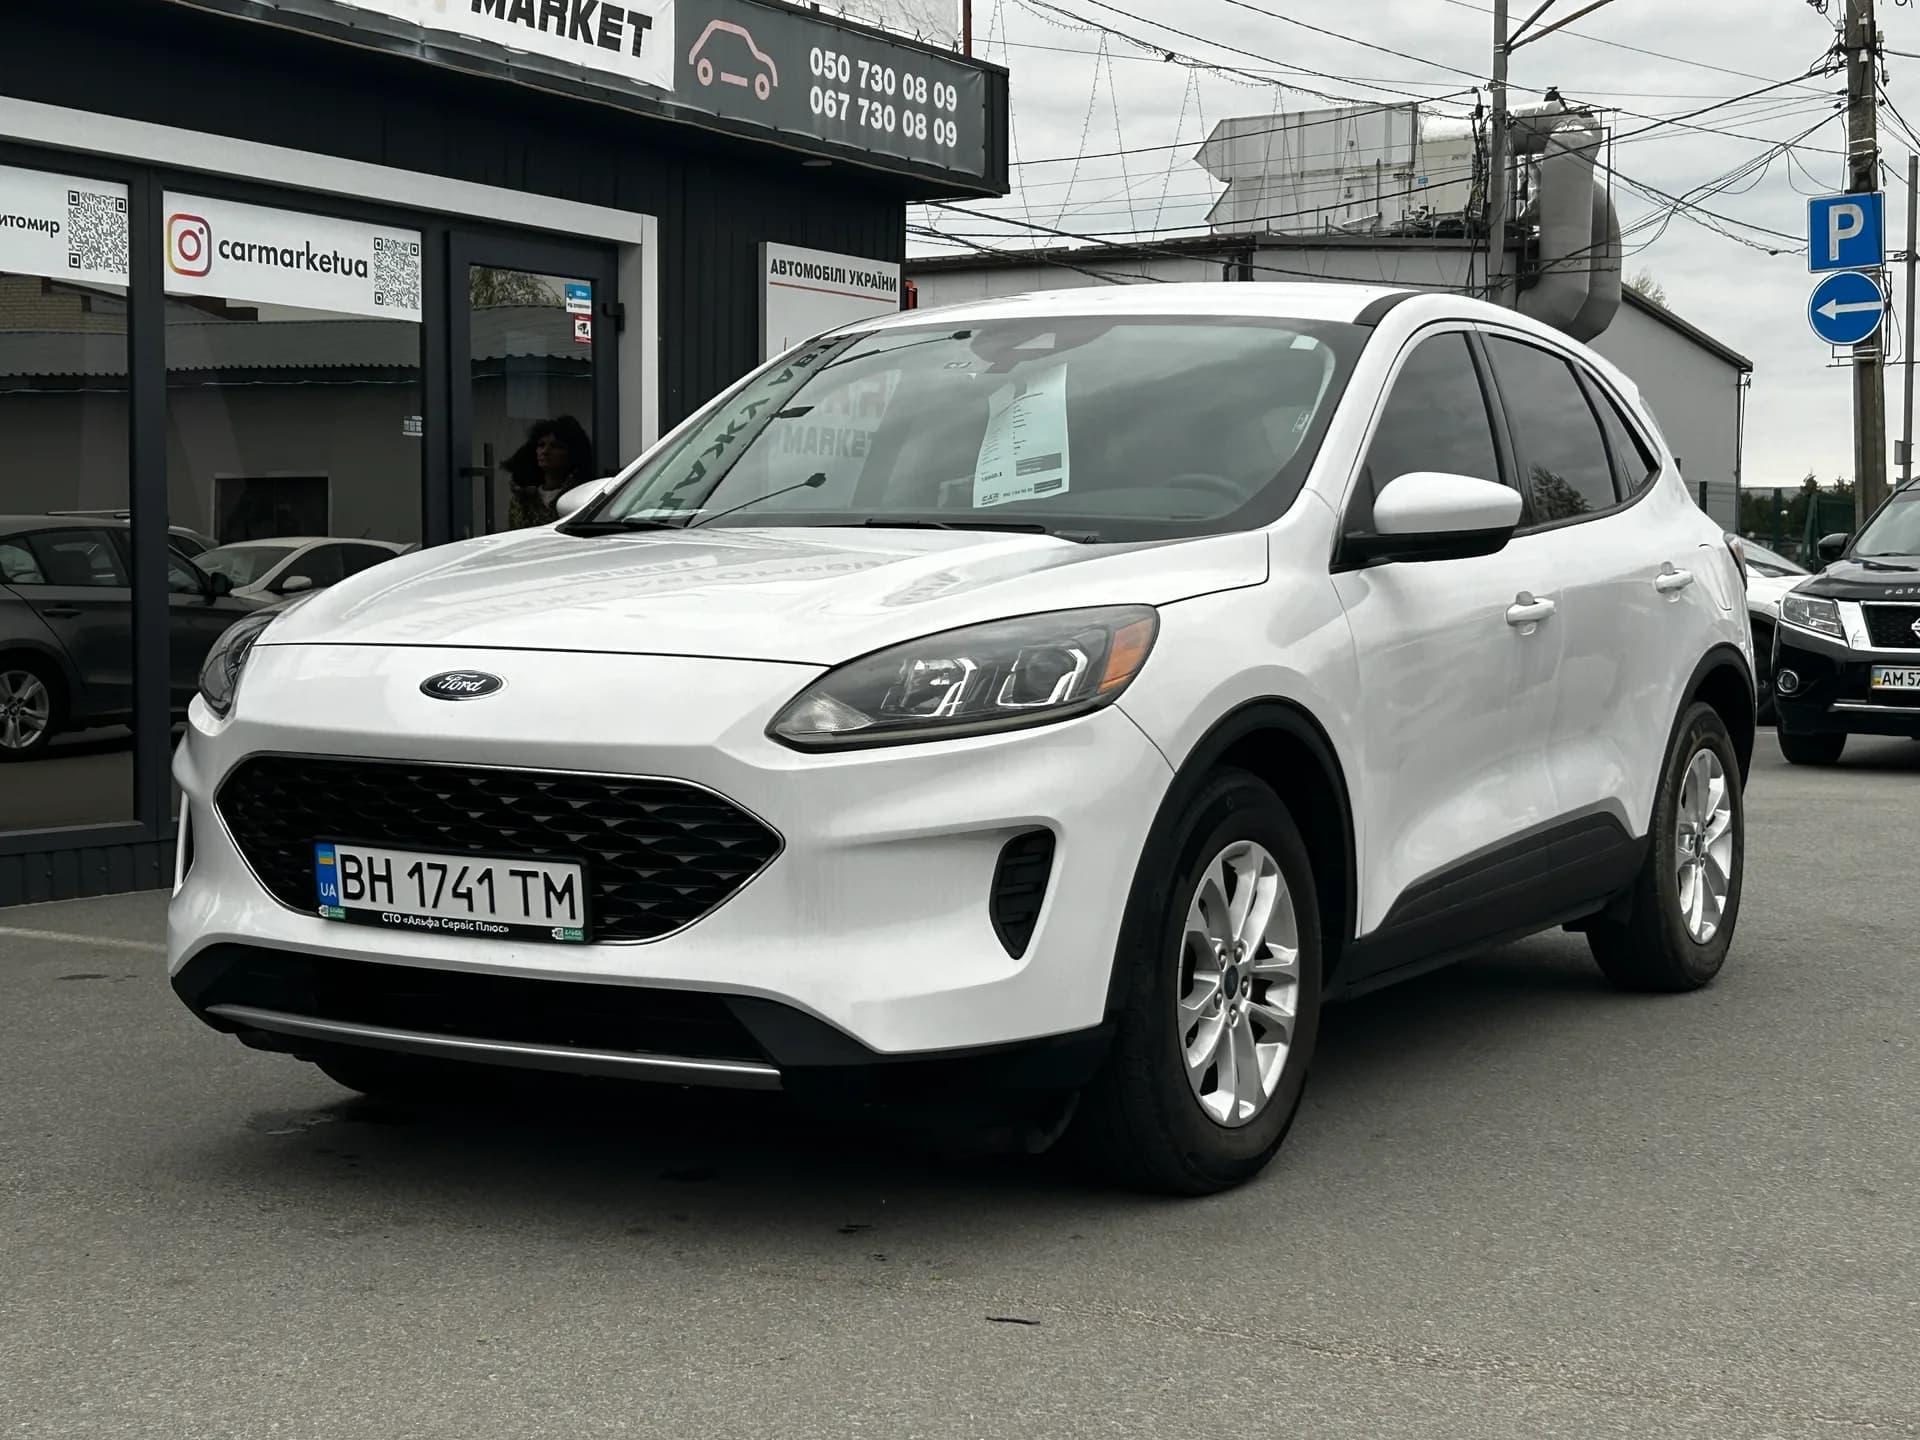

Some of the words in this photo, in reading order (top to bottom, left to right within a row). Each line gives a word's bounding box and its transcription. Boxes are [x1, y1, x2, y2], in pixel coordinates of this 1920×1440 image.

[809, 47, 850, 84] 050
[857, 59, 896, 96] 730
[902, 72, 928, 105] 08
[933, 81, 958, 113] 09
[809, 85, 850, 121] 067
[857, 97, 896, 133] 730
[902, 109, 928, 141] 08
[933, 117, 958, 148] 09
[1828, 203, 1865, 262] P
[218, 239, 369, 279] carmarketua
[770, 258, 846, 284] АВТОМОБІЛІ
[848, 269, 897, 293] УКРАЇНИ
[437, 673, 487, 692] Ford
[1881, 671, 1904, 686] AM
[320, 882, 337, 898] UA
[339, 853, 395, 905] BH
[407, 861, 497, 915] 1741
[509, 869, 577, 921] TM
[382, 912, 402, 924] СТО
[402, 915, 440, 929] «Альфа
[441, 918, 475, 932] Сервіс
[475, 921, 510, 933] Плюс»
